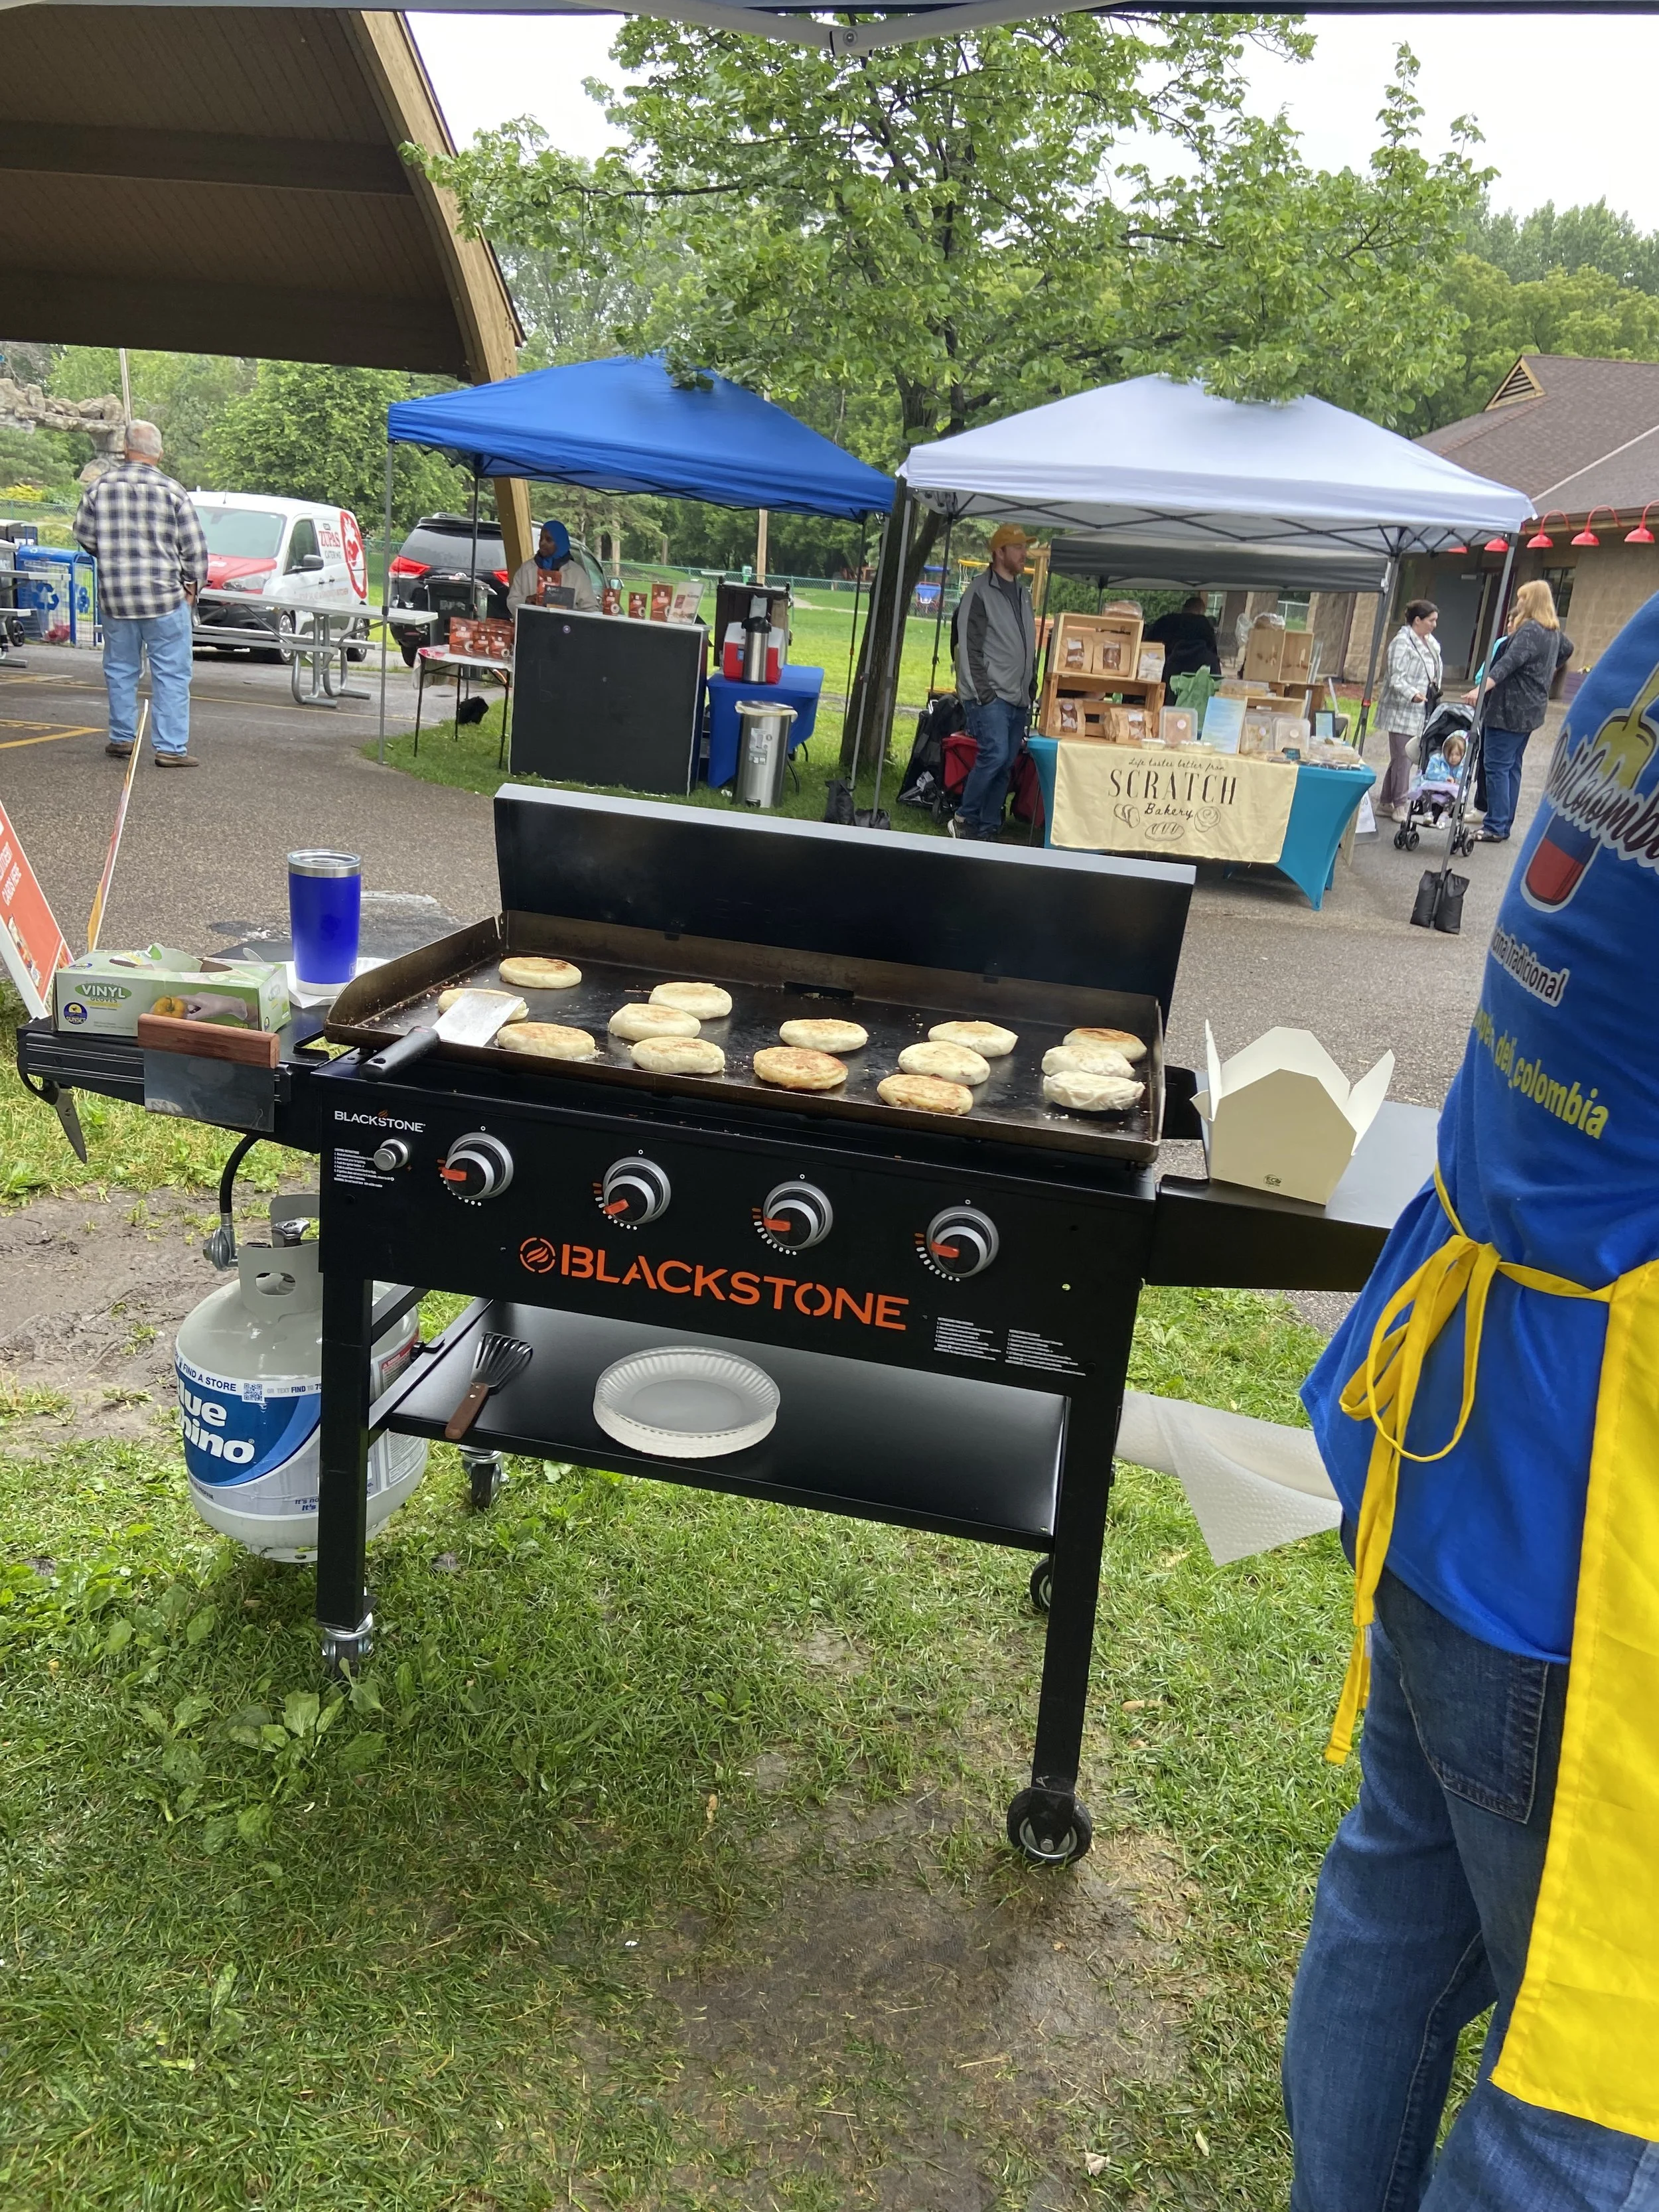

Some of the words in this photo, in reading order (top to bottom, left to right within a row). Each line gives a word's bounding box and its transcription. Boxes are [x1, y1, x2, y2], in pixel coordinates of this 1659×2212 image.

[319, 531, 340, 548] ZUPAS
[1129, 757, 1145, 769] Life
[1149, 759, 1174, 767] tastes
[1178, 759, 1203, 769] better
[1108, 769, 1240, 805] SCRATCH
[1144, 802, 1194, 820] Bakery
[1506, 938, 1566, 1001] Tradicional
[82, 984, 126, 998] VINYL
[334, 1110, 424, 1132] BLACKSTONE
[561, 1243, 909, 1331] BLACKSTONE
[183, 1363, 196, 1378] FIND
[198, 1374, 204, 1383] A
[206, 1377, 237, 1392] STORE
[178, 1377, 227, 1427] lue
[180, 1406, 255, 1464] hino
